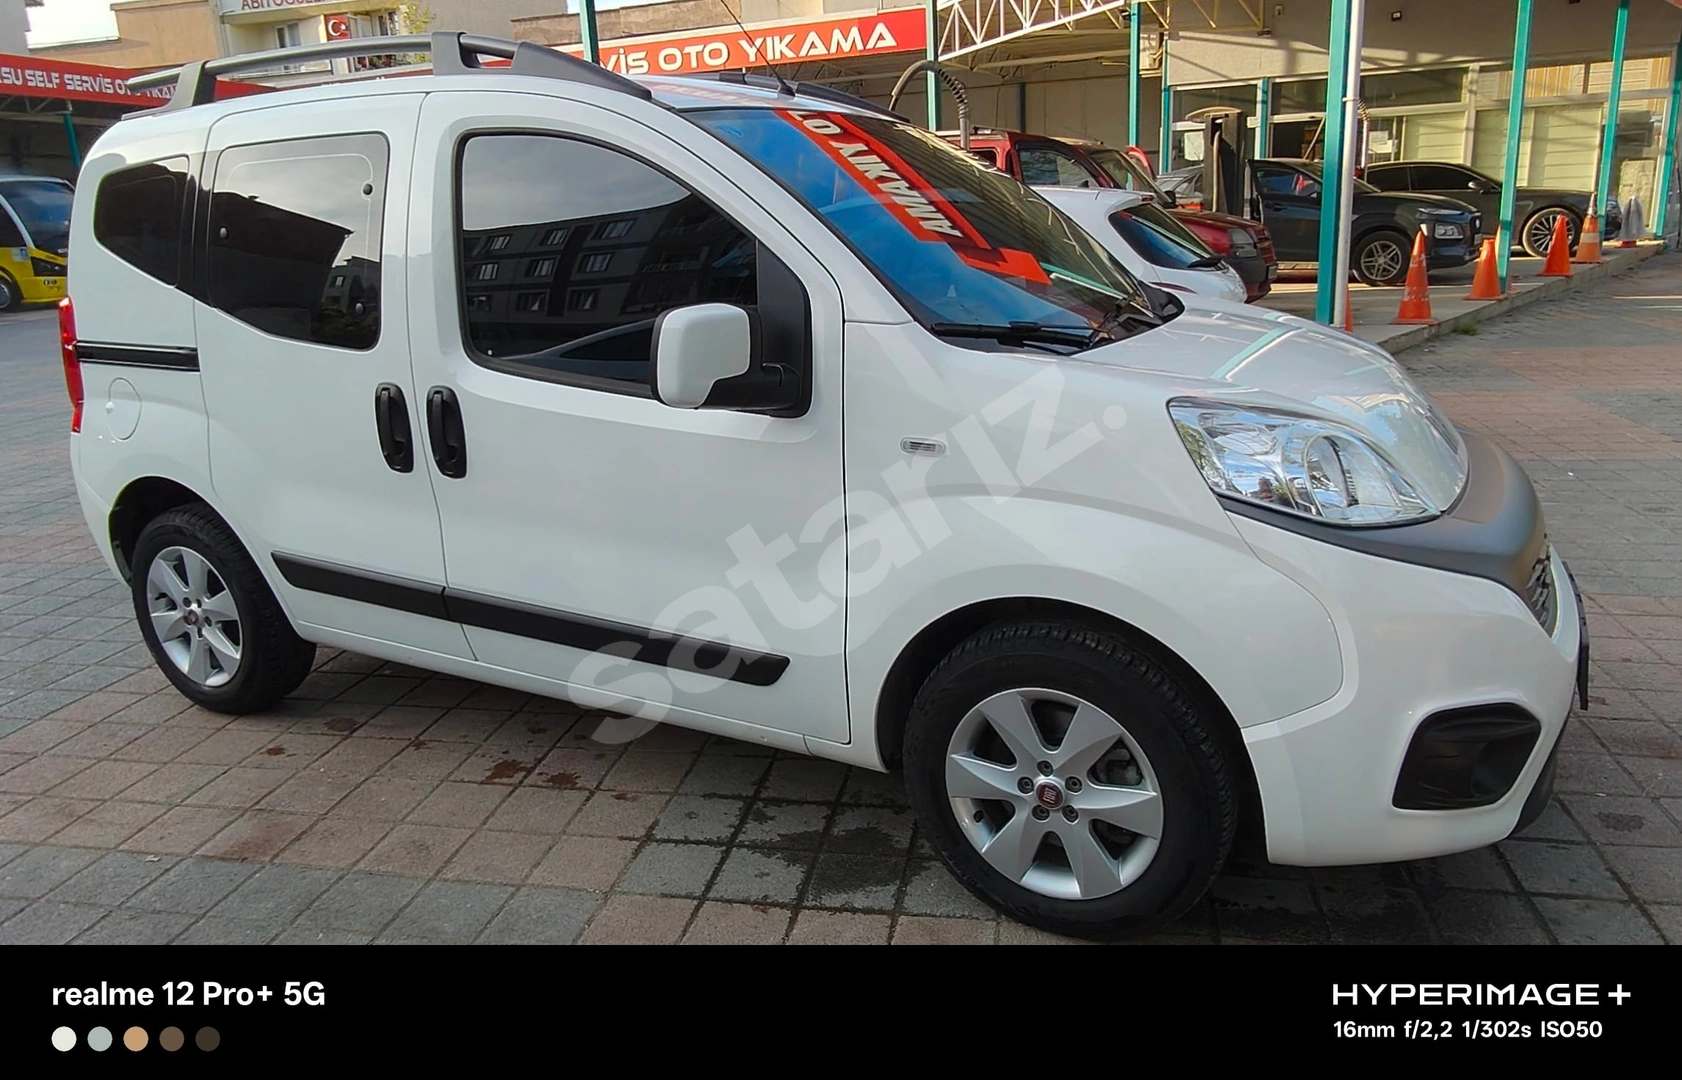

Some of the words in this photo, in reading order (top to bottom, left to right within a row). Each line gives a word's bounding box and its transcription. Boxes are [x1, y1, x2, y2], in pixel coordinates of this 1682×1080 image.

[658, 41, 729, 71] OTO
[738, 21, 898, 63] YIKAMA
[0, 66, 22, 86] SU
[25, 69, 60, 89] SELF
[64, 73, 112, 94] SERVİS
